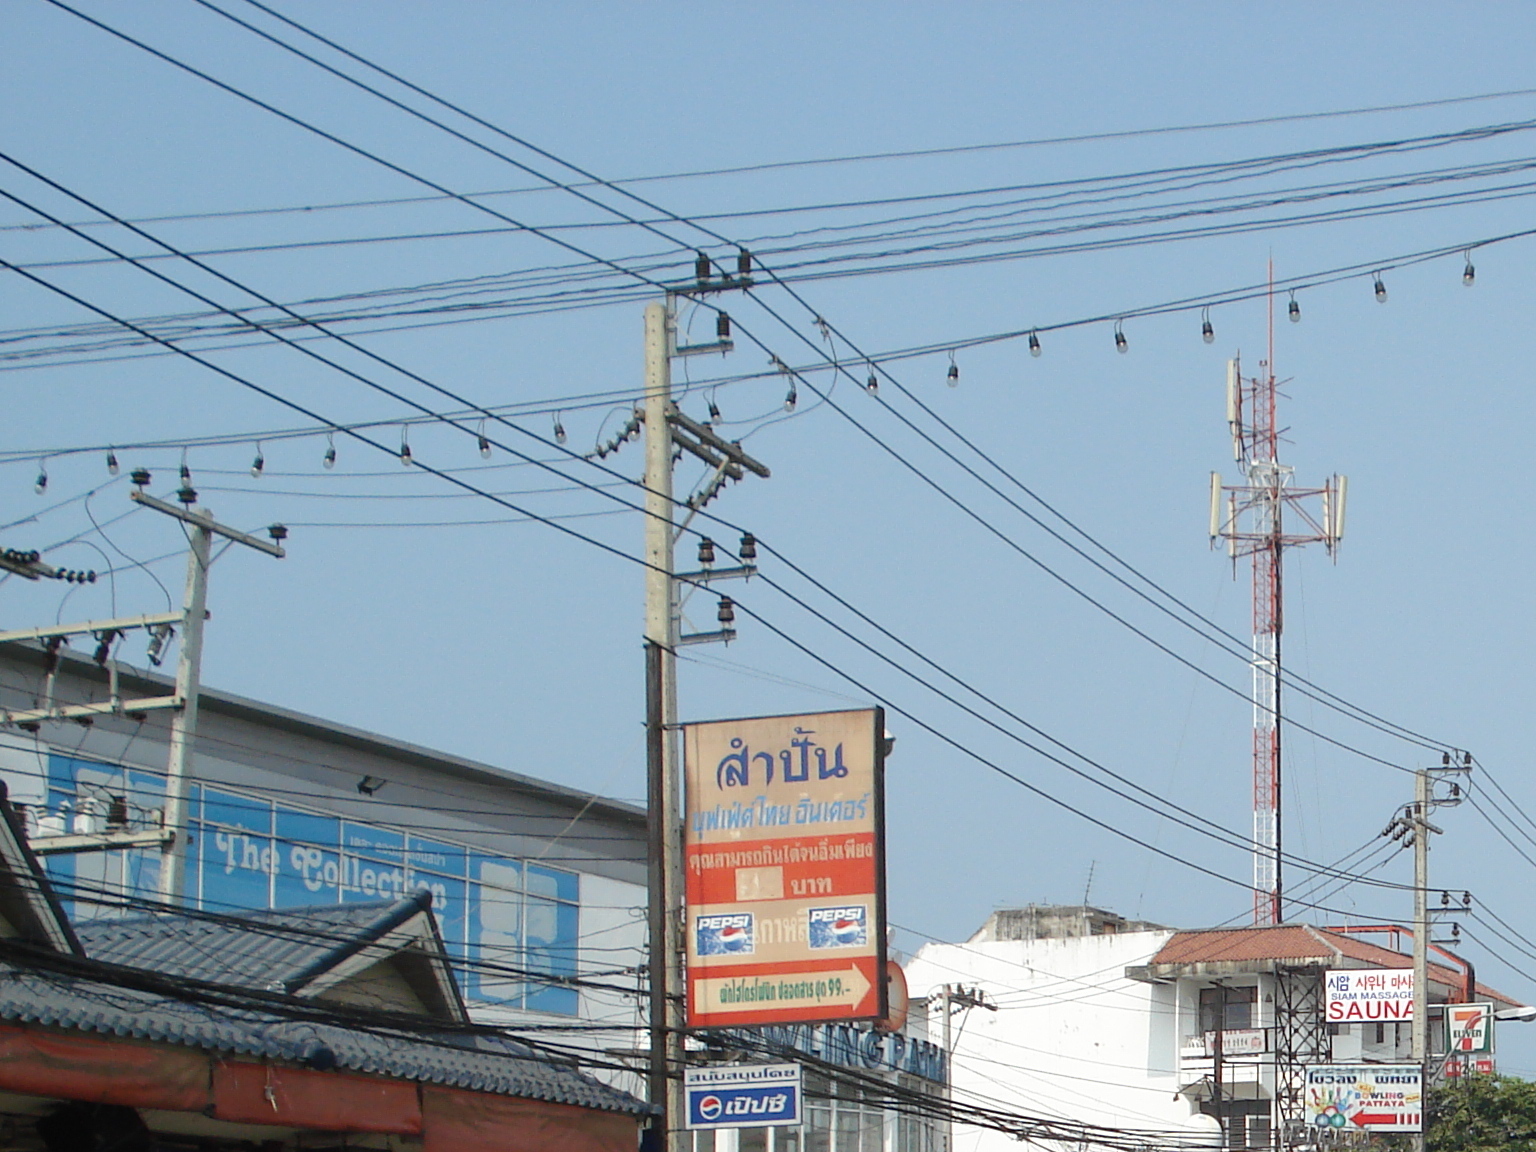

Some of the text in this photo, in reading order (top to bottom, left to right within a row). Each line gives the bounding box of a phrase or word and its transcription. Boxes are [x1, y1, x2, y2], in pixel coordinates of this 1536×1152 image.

[216, 824, 280, 876] The
[791, 876, 833, 895] บาท
[699, 915, 750, 930] PEPSI
[811, 908, 863, 923] PEPSI
[1355, 974, 1386, 991] 사우나
[1391, 973, 1414, 990] 마사
[1331, 992, 1357, 1000] SIAM
[1329, 1000, 1414, 1020] SAUNA
[1355, 1091, 1405, 1100] BOWLING
[1359, 1100, 1405, 1108] PATTAYA
